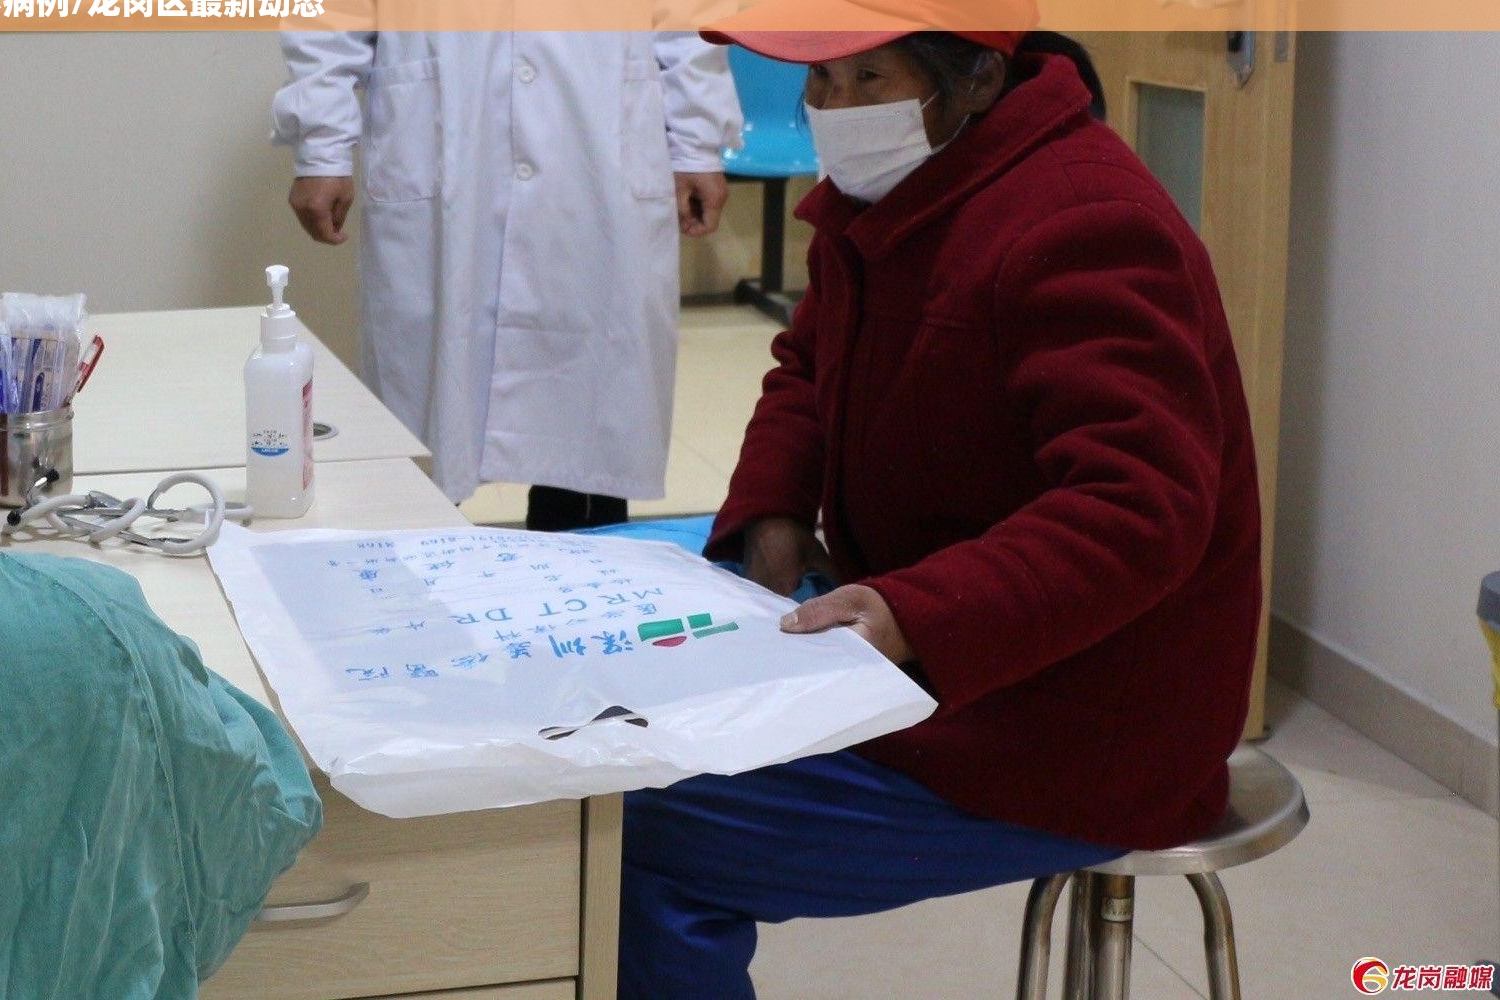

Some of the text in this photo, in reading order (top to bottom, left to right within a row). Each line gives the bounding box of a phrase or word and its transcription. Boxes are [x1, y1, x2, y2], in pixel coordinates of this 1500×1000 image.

[597, 587, 664, 606] MR
[447, 607, 514, 626] DR
[538, 598, 588, 618] CT
